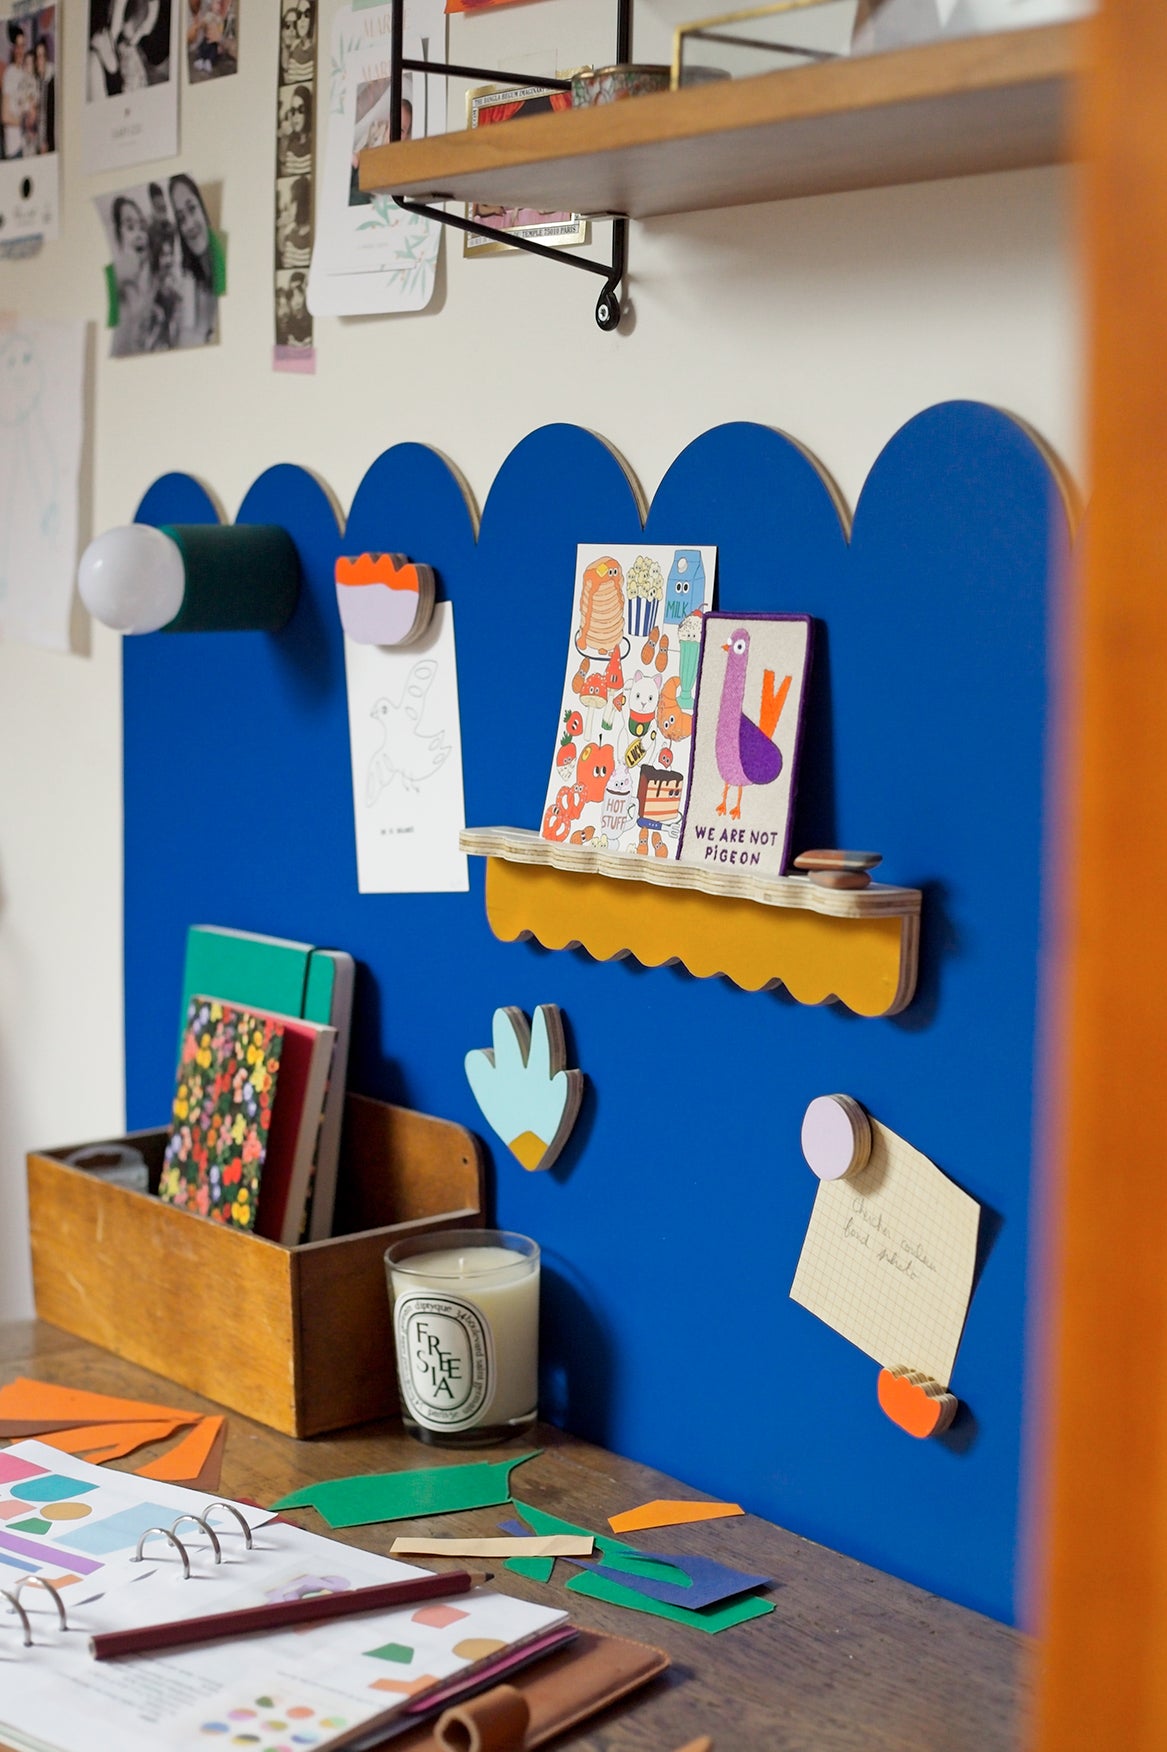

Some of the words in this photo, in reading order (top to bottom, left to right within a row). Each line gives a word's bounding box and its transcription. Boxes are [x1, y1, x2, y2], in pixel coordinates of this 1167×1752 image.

[363, 9, 412, 38] MARE
[522, 227, 542, 238] TEMPLE
[543, 225, 560, 236] 75010
[560, 223, 577, 234] PARIS
[665, 600, 689, 619] MILK
[626, 741, 646, 766] LUCK
[606, 798, 626, 814] HOT
[601, 815, 627, 831] STUFF
[695, 825, 716, 841] WE
[719, 827, 746, 843] ARE
[749, 830, 778, 847] NOT
[876, 1249, 919, 1280] photo
[415, 1301, 453, 1313] diptyque
